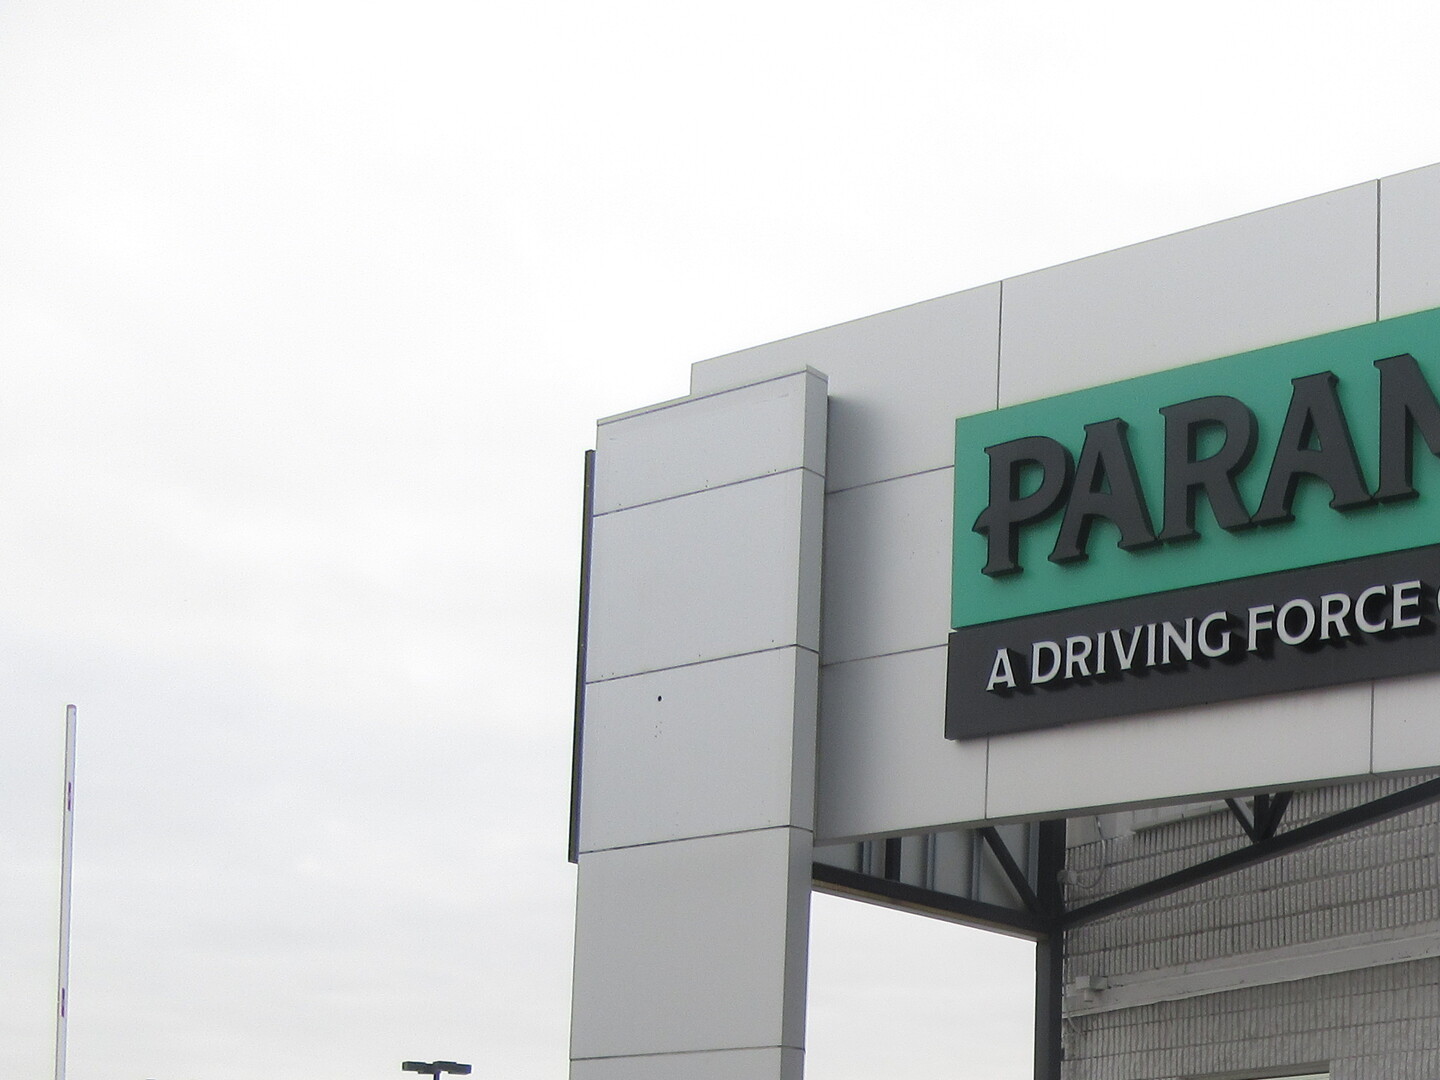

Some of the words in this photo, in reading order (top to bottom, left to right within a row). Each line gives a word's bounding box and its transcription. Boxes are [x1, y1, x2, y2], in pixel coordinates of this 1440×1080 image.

[985, 647, 1017, 691] A
[1030, 611, 1229, 685] DRIVING
[1246, 580, 1421, 652] FORCE
